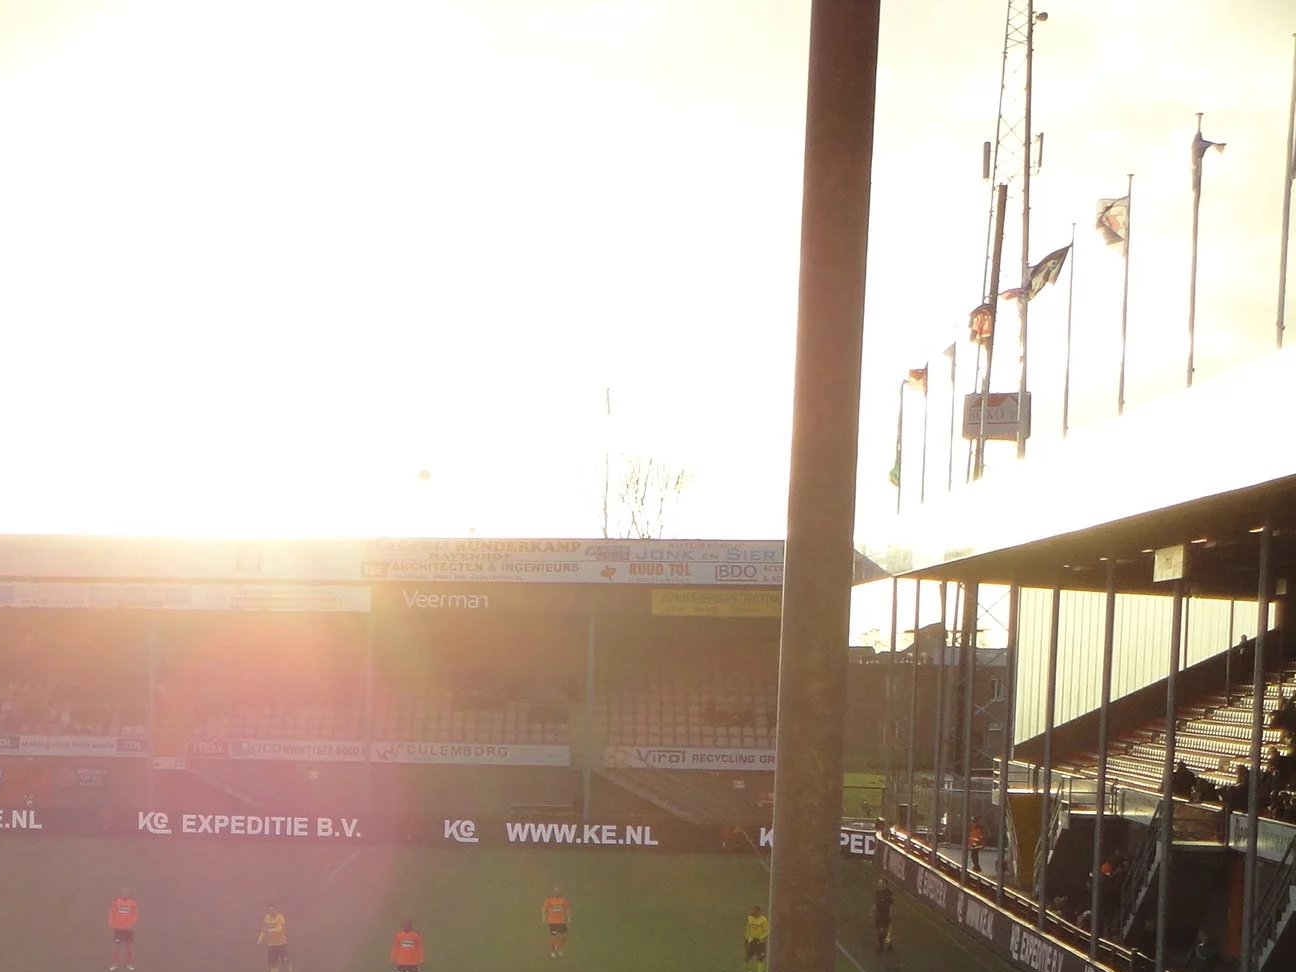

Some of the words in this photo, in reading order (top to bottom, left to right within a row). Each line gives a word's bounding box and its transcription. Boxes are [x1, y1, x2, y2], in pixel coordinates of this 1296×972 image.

[635, 549, 695, 561] JONK
[726, 549, 777, 561] SIER
[392, 562, 484, 573] ARCHITECTEN
[501, 563, 581, 573] INGENIEURS
[628, 562, 664, 576] RUUD
[717, 564, 758, 578] BDO
[402, 589, 489, 609] Veerman
[406, 744, 509, 758] CULEMBORG
[692, 754, 757, 764] RECYCLING
[181, 814, 309, 837] EXPEDITIE
[316, 817, 362, 838] B.V.
[506, 822, 659, 846] WWW.KE.NL
